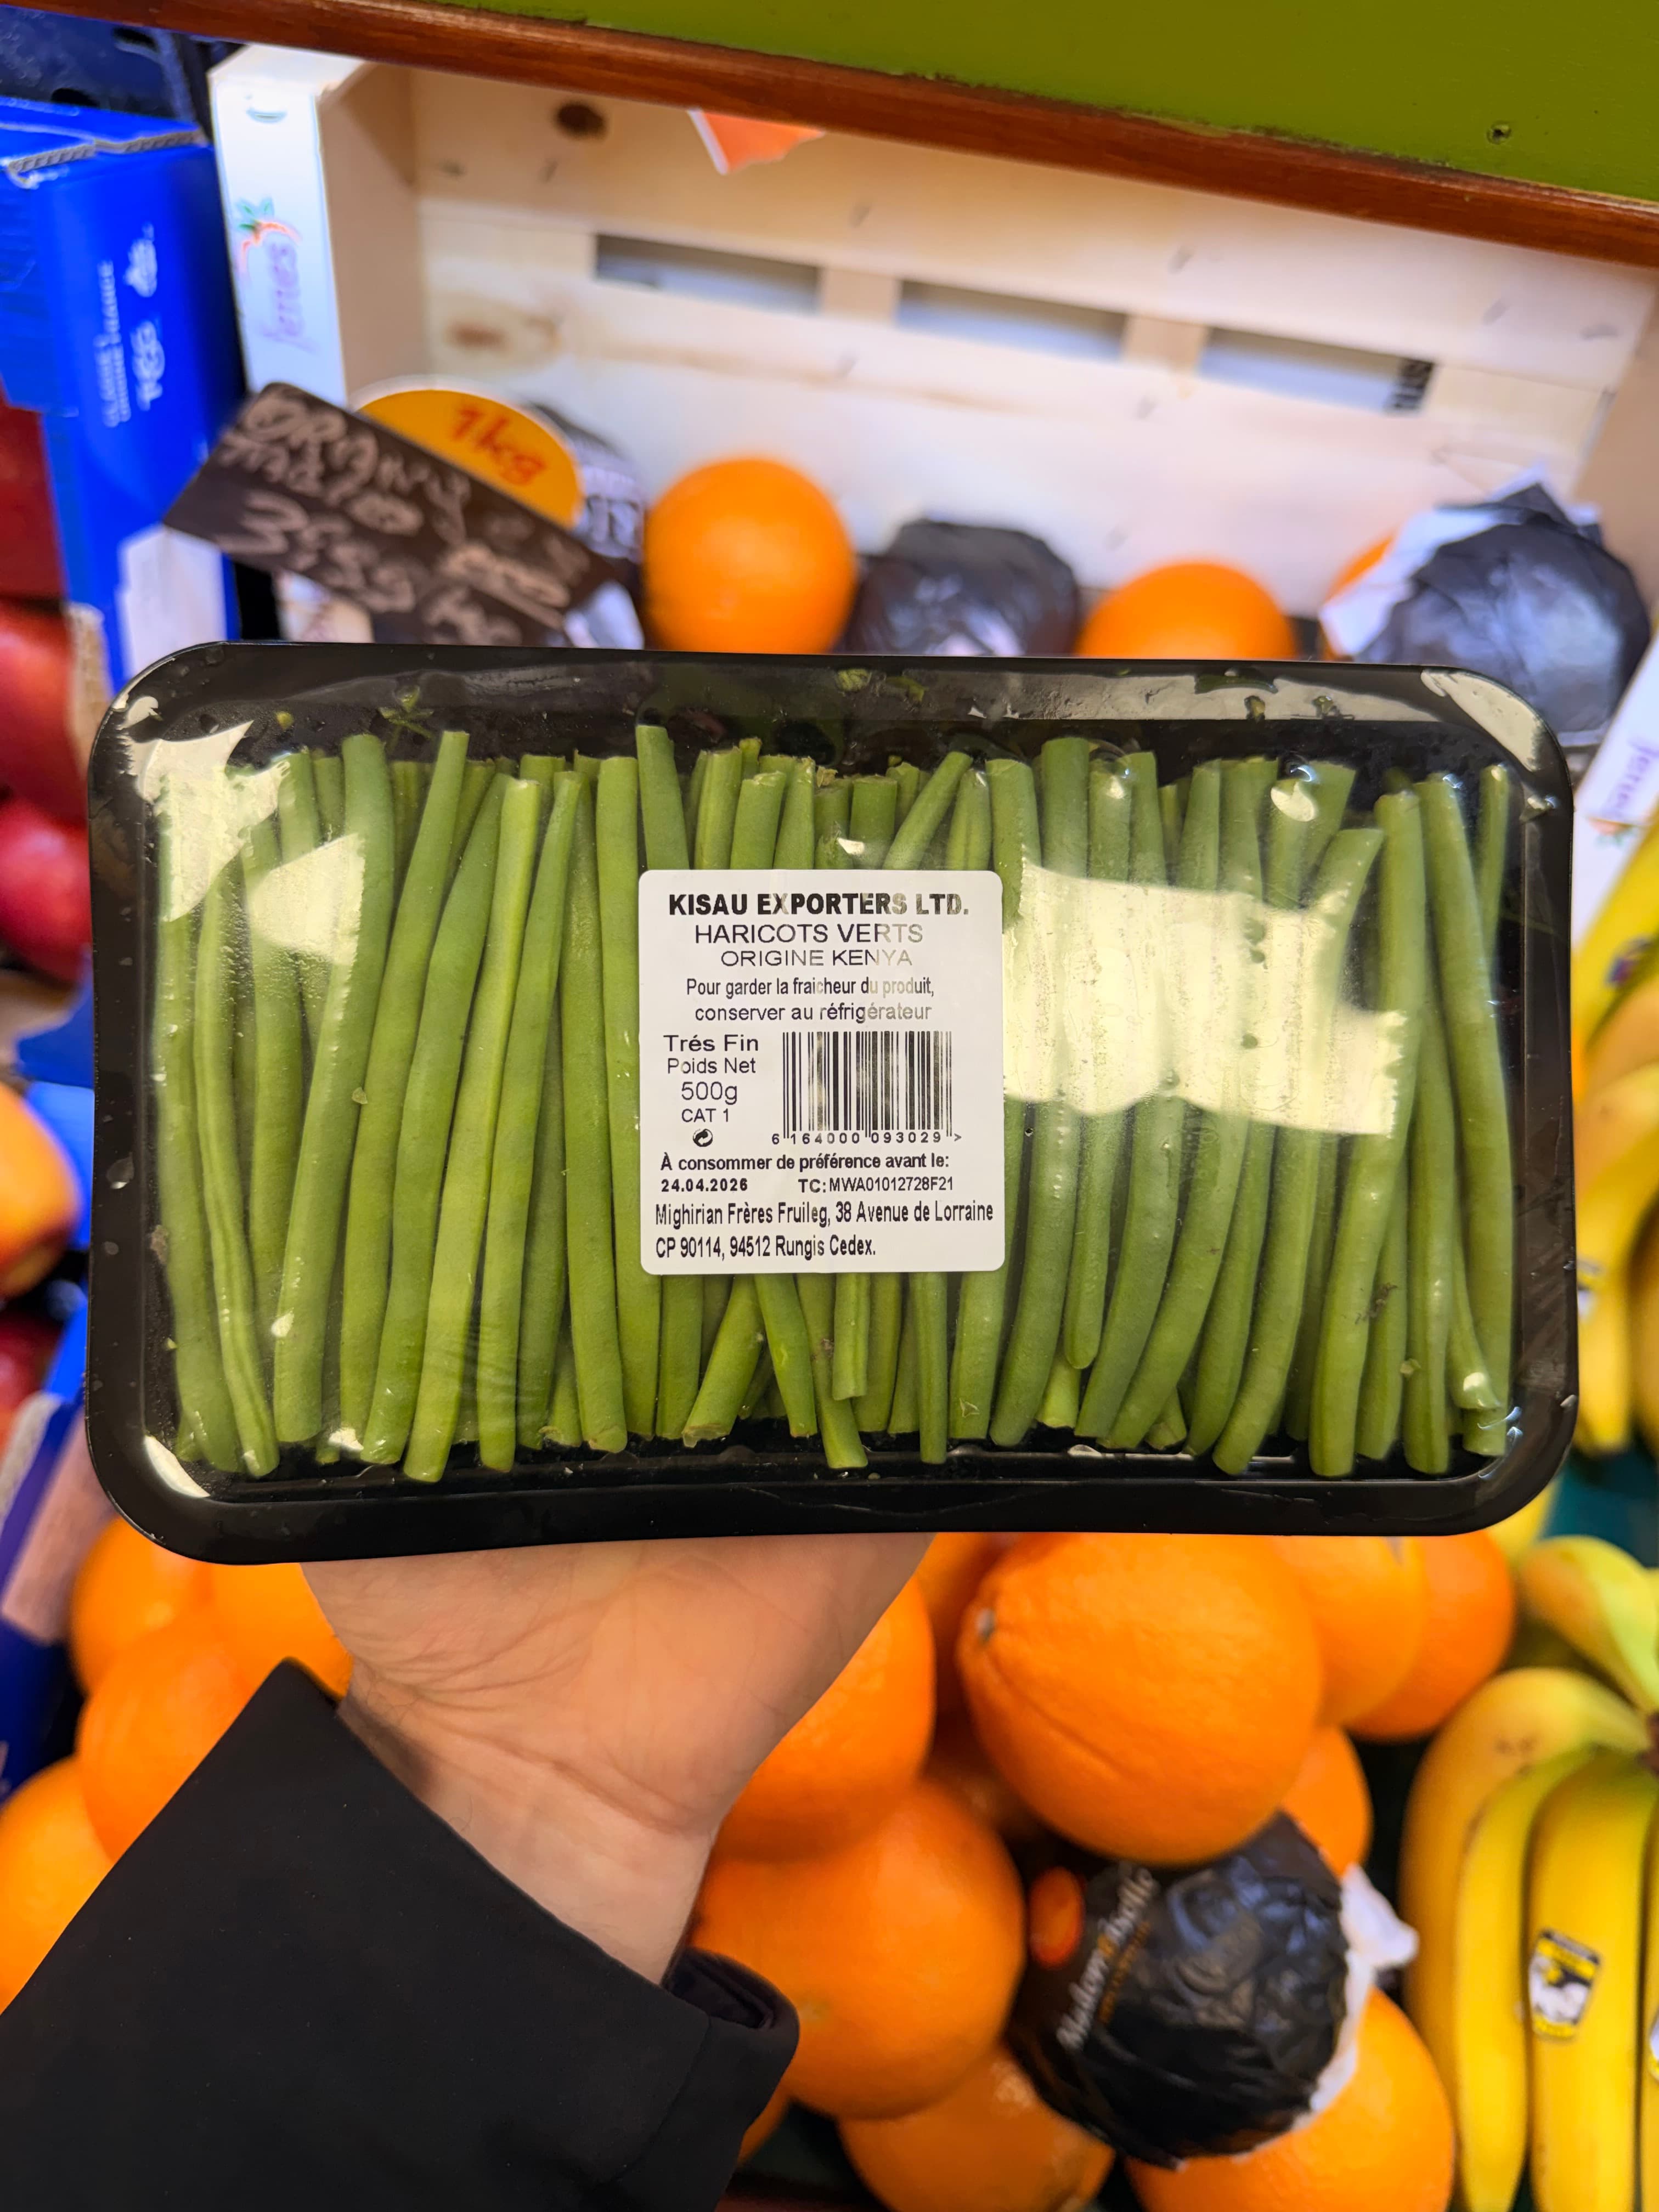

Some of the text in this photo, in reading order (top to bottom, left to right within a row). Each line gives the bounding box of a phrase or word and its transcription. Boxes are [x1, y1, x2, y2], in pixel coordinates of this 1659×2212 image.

[669, 893, 969, 916] KISAU EXPORTERS LTD.
[696, 923, 923, 944] HARICOTS VERTS
[721, 949, 912, 967] ORIGINE KENYA
[687, 978, 721, 995] Pour
[726, 978, 772, 1000] garder
[777, 977, 788, 995] la
[861, 976, 878, 994] du
[883, 977, 934, 999] produit,
[695, 1002, 932, 1024] conserver au réfrigérateur
[663, 1034, 759, 1052] Trés Fin
[667, 1057, 756, 1074] Poids Net
[681, 1081, 738, 1105] 500g
[681, 1108, 729, 1122] CAT 1
[660, 1152, 949, 1173] À consommer de préférence avant le:
[661, 1178, 748, 1193] 24.04.2026
[656, 1200, 994, 1230] Mighirian Frères Fruileg, 38 Avenue de Lorraine
[656, 1234, 876, 1261] CP 90114, 94512 Rungis Cedex.
